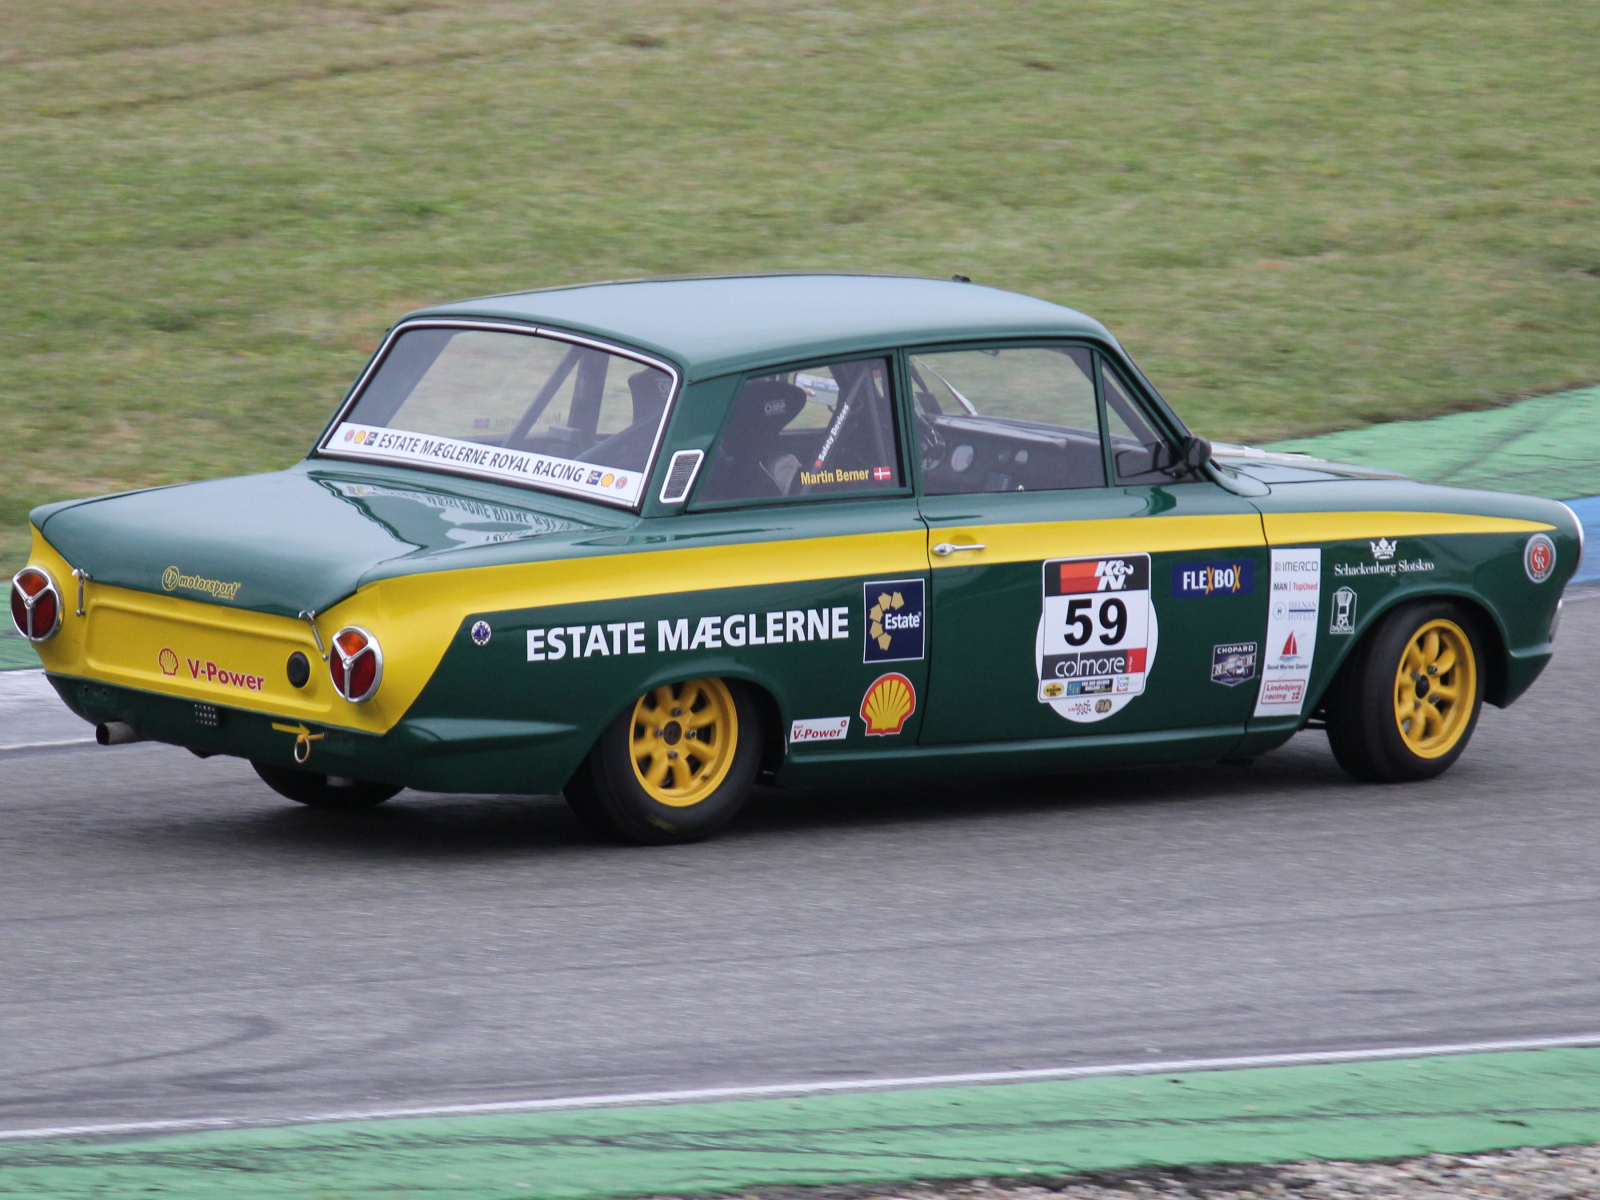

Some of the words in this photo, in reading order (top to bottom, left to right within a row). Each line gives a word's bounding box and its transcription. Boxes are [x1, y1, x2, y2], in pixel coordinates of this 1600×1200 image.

[764, 401, 786, 413] OMP
[818, 435, 834, 461] Safety
[831, 402, 850, 436] Devices
[378, 433, 421, 453] ESTATE
[420, 440, 489, 466] MÆGLERNE
[489, 452, 531, 473] ROYAL
[532, 460, 585, 482] RACING
[800, 470, 834, 484] Martin
[836, 469, 869, 482] Berner
[1283, 561, 1318, 572] IMERCO
[1334, 561, 1397, 577] Schackenborg
[1398, 558, 1434, 572] Slotskro
[179, 575, 238, 597] motorsport
[1183, 564, 1241, 595] FLEXBOX
[1274, 582, 1288, 591] MAN
[1293, 582, 1318, 592] TopUsed
[885, 612, 921, 630] Estate
[1064, 598, 1127, 646] 59
[526, 621, 646, 661] ESTATE
[657, 607, 849, 652] MÆGLERNE
[1217, 645, 1254, 654] CHOPARD
[1055, 652, 1125, 677] colmore
[187, 657, 264, 691] V-Power
[1265, 692, 1286, 701] racing
[1266, 684, 1302, 692] Lindebjerg
[1096, 701, 1111, 712] FIA
[793, 728, 842, 740] V-Power
